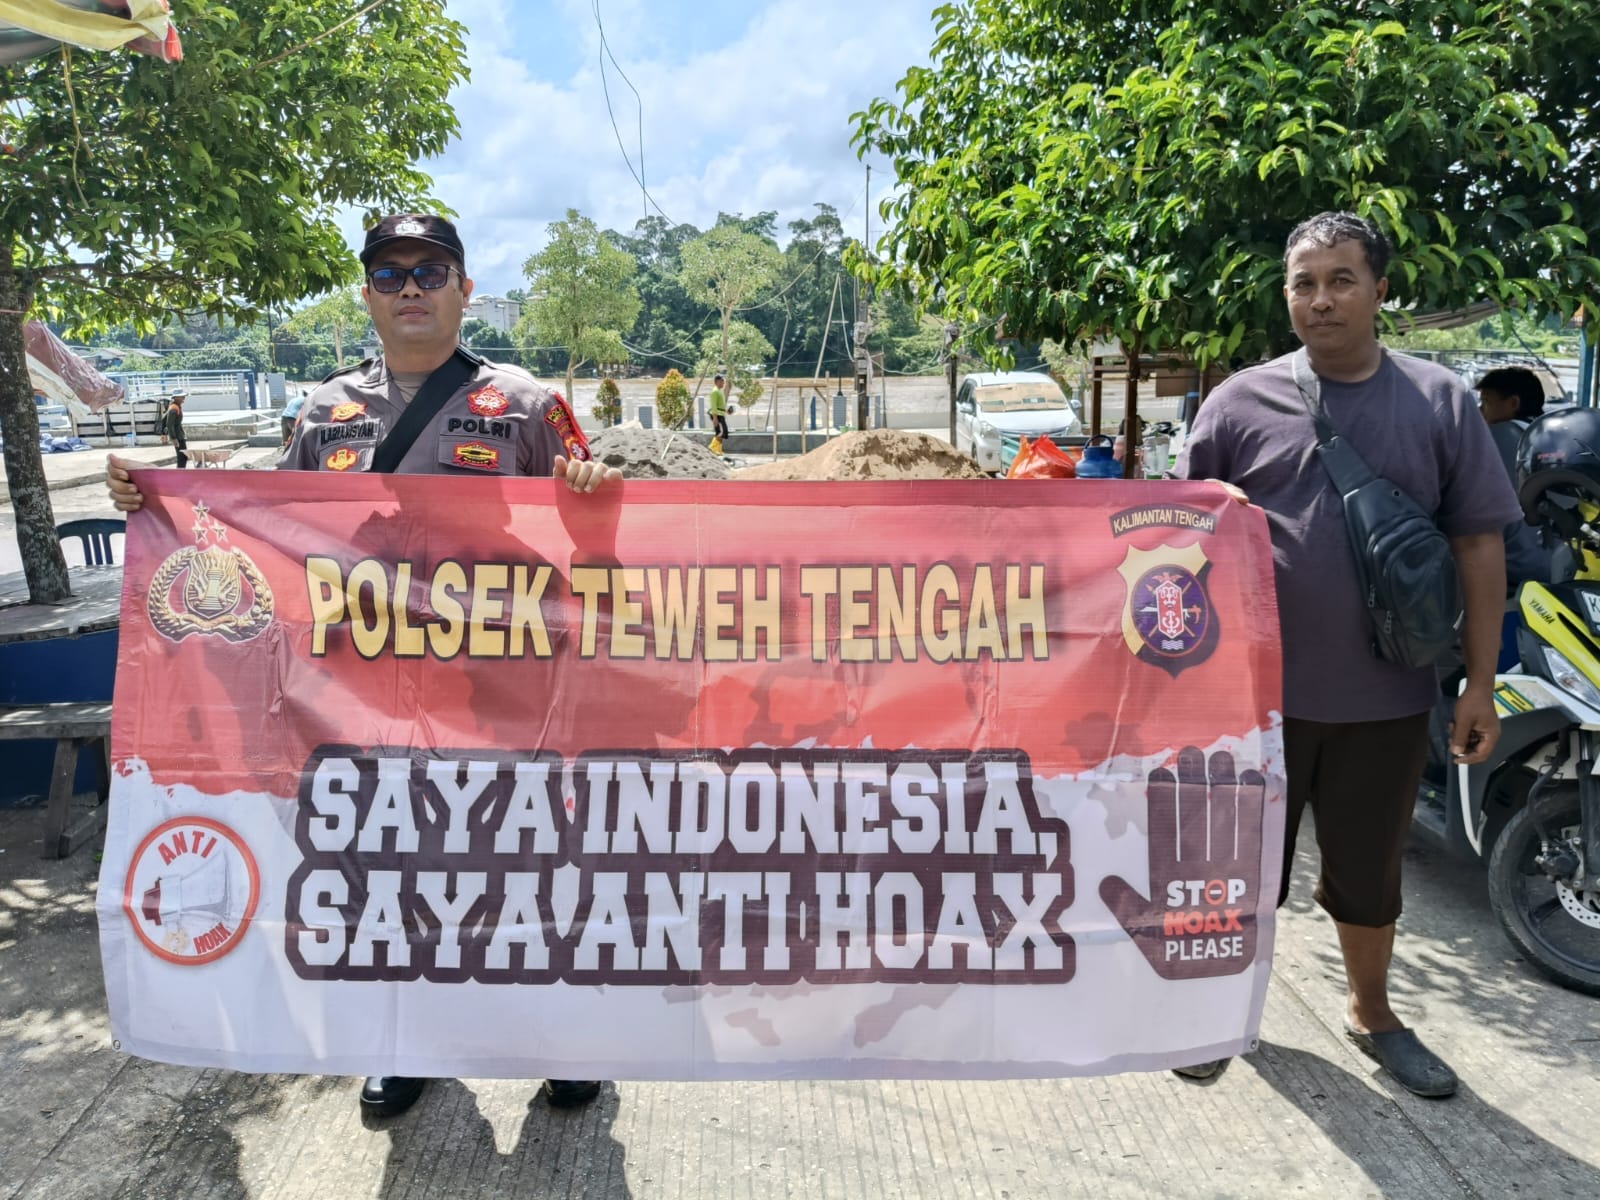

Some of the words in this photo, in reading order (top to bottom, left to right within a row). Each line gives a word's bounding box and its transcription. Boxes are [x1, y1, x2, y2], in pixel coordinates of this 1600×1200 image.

[448, 418, 511, 439] POLRI
[1113, 509, 1173, 533] KALIMANTAN
[1174, 509, 1214, 531] TENGAH
[304, 554, 553, 661] POLSEK
[570, 562, 782, 663] TEWEH
[800, 560, 1050, 665] TENGAH
[1529, 598, 1556, 625] YAMAHA
[308, 757, 559, 854] SAYA
[582, 760, 1057, 871] INDONESIA,
[158, 830, 218, 866] ANTI
[1166, 879, 1247, 907] STOP
[298, 869, 550, 970] SAYA
[573, 871, 791, 971] ANTI
[815, 871, 1064, 970] HOAX
[1163, 908, 1245, 936] HOAX
[193, 921, 232, 954] HOAX
[1165, 936, 1244, 962] PLEASE
